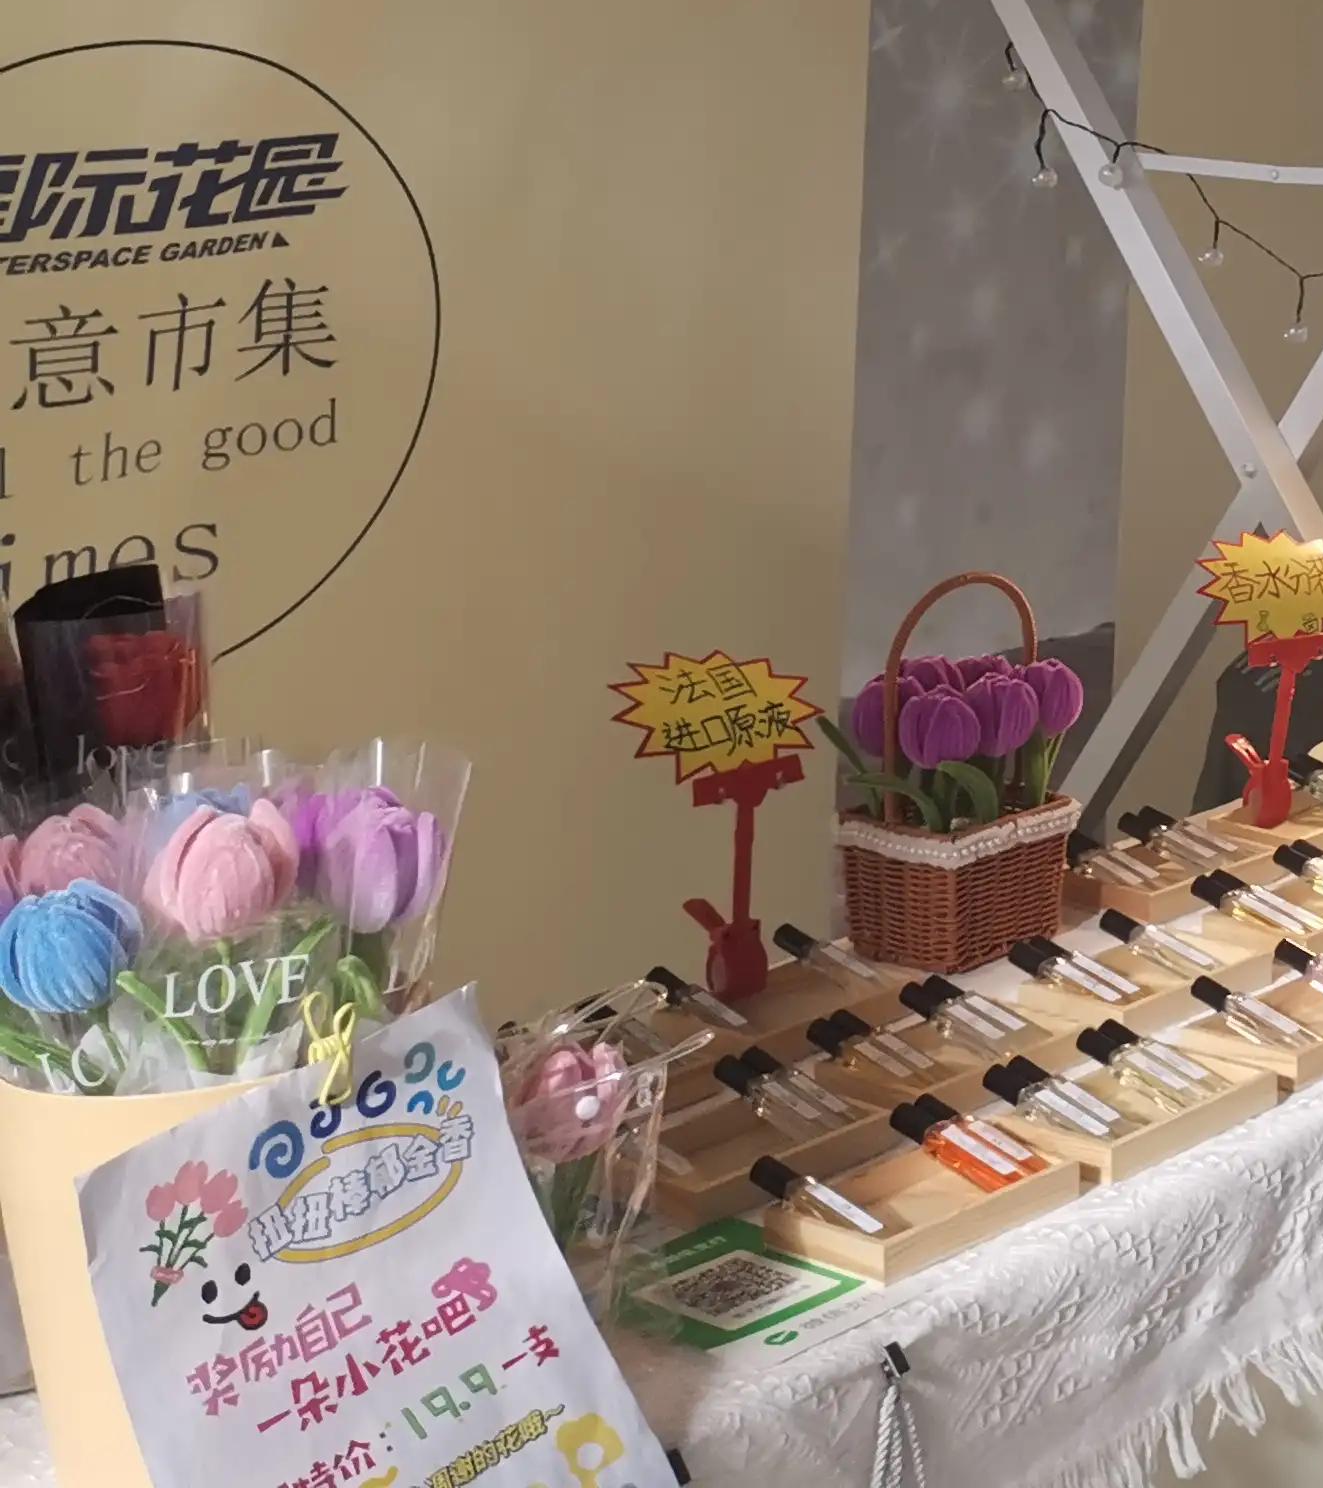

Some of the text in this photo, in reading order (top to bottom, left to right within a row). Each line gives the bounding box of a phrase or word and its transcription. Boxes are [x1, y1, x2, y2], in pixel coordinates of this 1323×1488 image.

[160, 231, 270, 262] GARDEN
[70, 432, 161, 486] the
[201, 398, 338, 471] good
[656, 663, 757, 704] 法国
[662, 702, 798, 756] 进口原液
[164, 954, 311, 1019] LOVE
[185, 1282, 373, 1416] 奖励自己
[257, 1292, 476, 1432] 一朵小花吧
